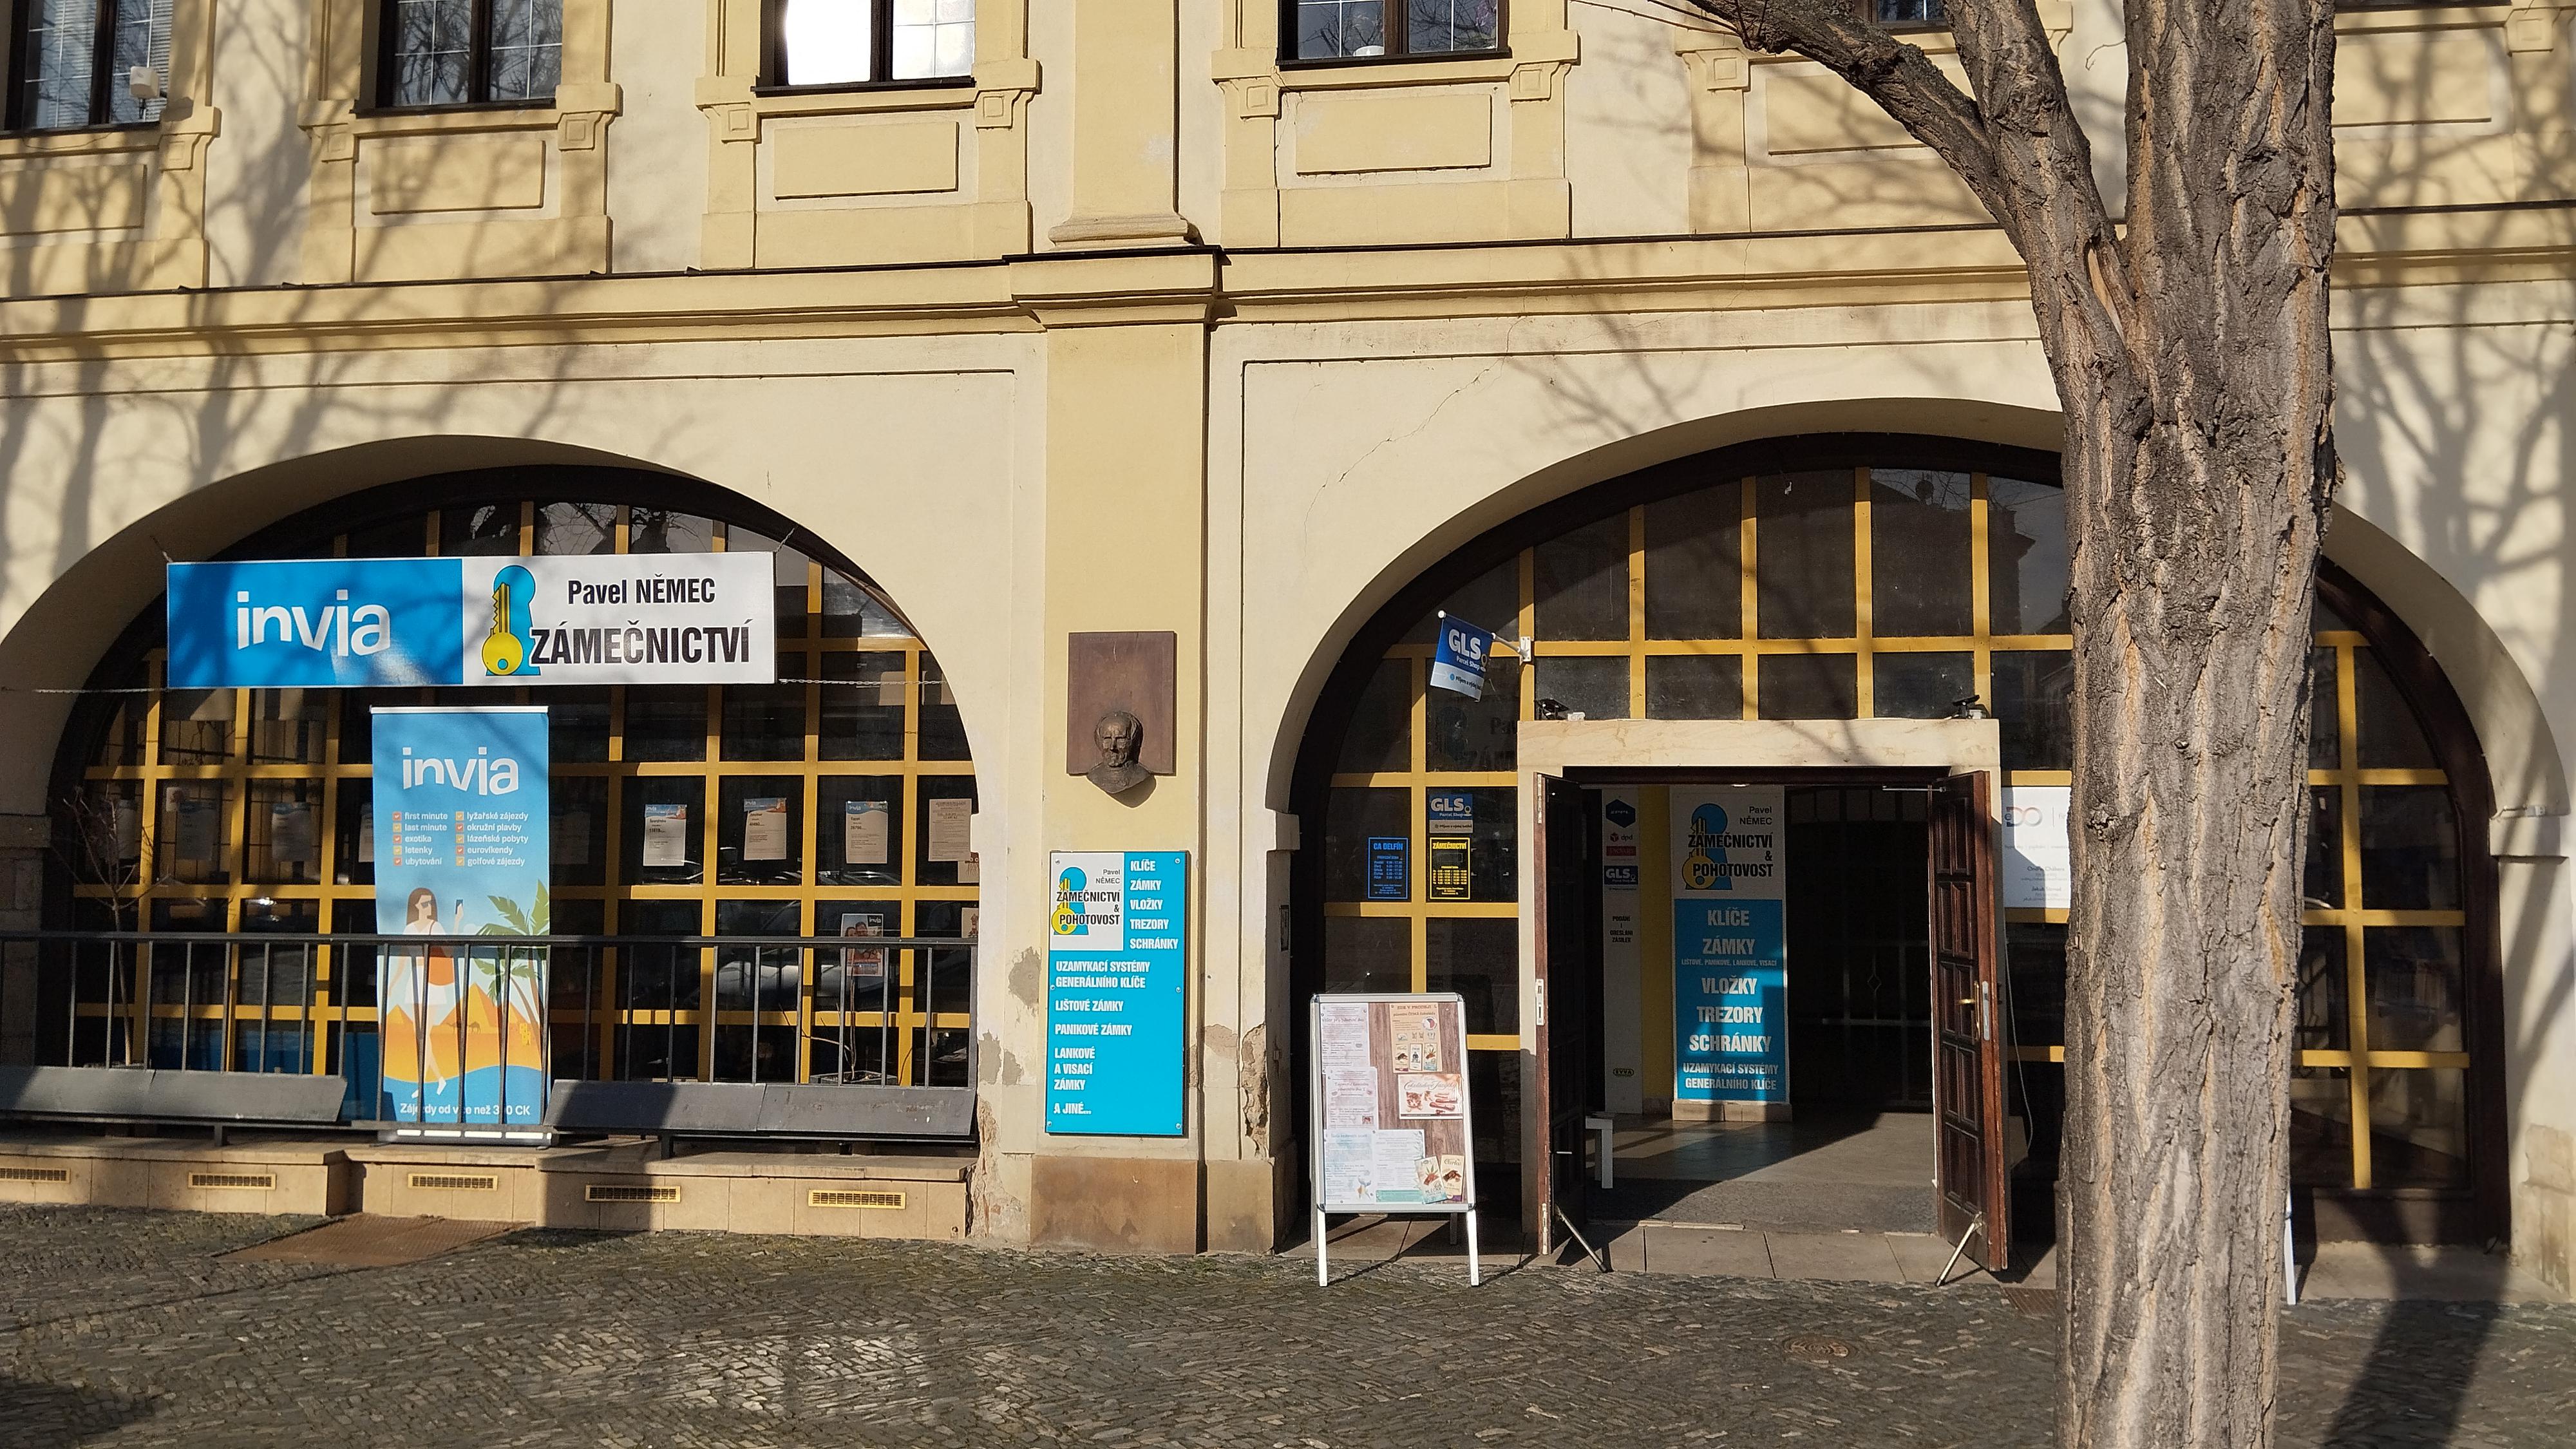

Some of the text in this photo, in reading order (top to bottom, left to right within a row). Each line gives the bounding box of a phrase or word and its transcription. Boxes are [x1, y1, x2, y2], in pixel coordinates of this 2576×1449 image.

[567, 573, 715, 604] Pavel NĚMEC
[236, 590, 390, 658] invia
[531, 618, 752, 665] ZÁMEČNICTVÍ
[1449, 629, 1481, 660] GLS
[1456, 656, 1480, 671] Parcel Shop
[402, 747, 518, 795] invia
[1431, 798, 1464, 811] GLS
[404, 812, 420, 820] first
[467, 812, 528, 822] lyžařské zájezdy
[1739, 816, 1772, 825] NĚMEC
[497, 824, 522, 833] plavby
[502, 835, 528, 844] pobyty
[1688, 831, 1773, 848] ZÁMEČNICTVÍ
[405, 846, 433, 855] letenky
[468, 846, 513, 855] eurovíkendy
[1765, 850, 1772, 861] &
[405, 858, 442, 866] ubytování
[468, 858, 525, 867] golfové zájezdy
[1130, 858, 1156, 871] KLÍČE
[1605, 868, 1631, 878] GLS
[1693, 864, 1773, 876] POHOTOVOST
[1130, 878, 1161, 891] ZÁMKY
[1056, 889, 1121, 902] ZÁMEČNICTVÍ
[1114, 904, 1120, 913] &
[1130, 898, 1163, 910] VLOŽKY
[1059, 914, 1121, 925] POHOTOVOST
[1707, 907, 1750, 927] KLÍČE
[1130, 918, 1169, 930] TREZORY
[1130, 936, 1179, 949] SCHRÁNKY
[1703, 935, 1756, 954] ZÁMKY
[1056, 960, 1150, 972] UZAMYKACÍ SYSTÉMY
[1056, 975, 1146, 989] GENERÁLNÍHO KLÍČE
[1701, 975, 1757, 995] VLOŽKY
[1055, 998, 1124, 1012] LIŠTOVÉ ZÁMKY
[1696, 1006, 1763, 1023] TREZORY
[1055, 1023, 1132, 1036] PANIKOVÉ ZÁMKY
[1689, 1032, 1772, 1052] SCHRÁNKY
[1055, 1046, 1095, 1059] LANKOVÉ
[1054, 1062, 1093, 1075] A VISACÍ
[1683, 1061, 1778, 1075] UZAMYKACÍ SYSTÉMY
[1054, 1077, 1085, 1090] ZÁMKY
[1685, 1077, 1777, 1090] GENERÁLNÍHO KLÍČE
[400, 1103, 530, 1117] Zájdy od ve než 30 CK
[1054, 1101, 1092, 1114] A JINÉ...
